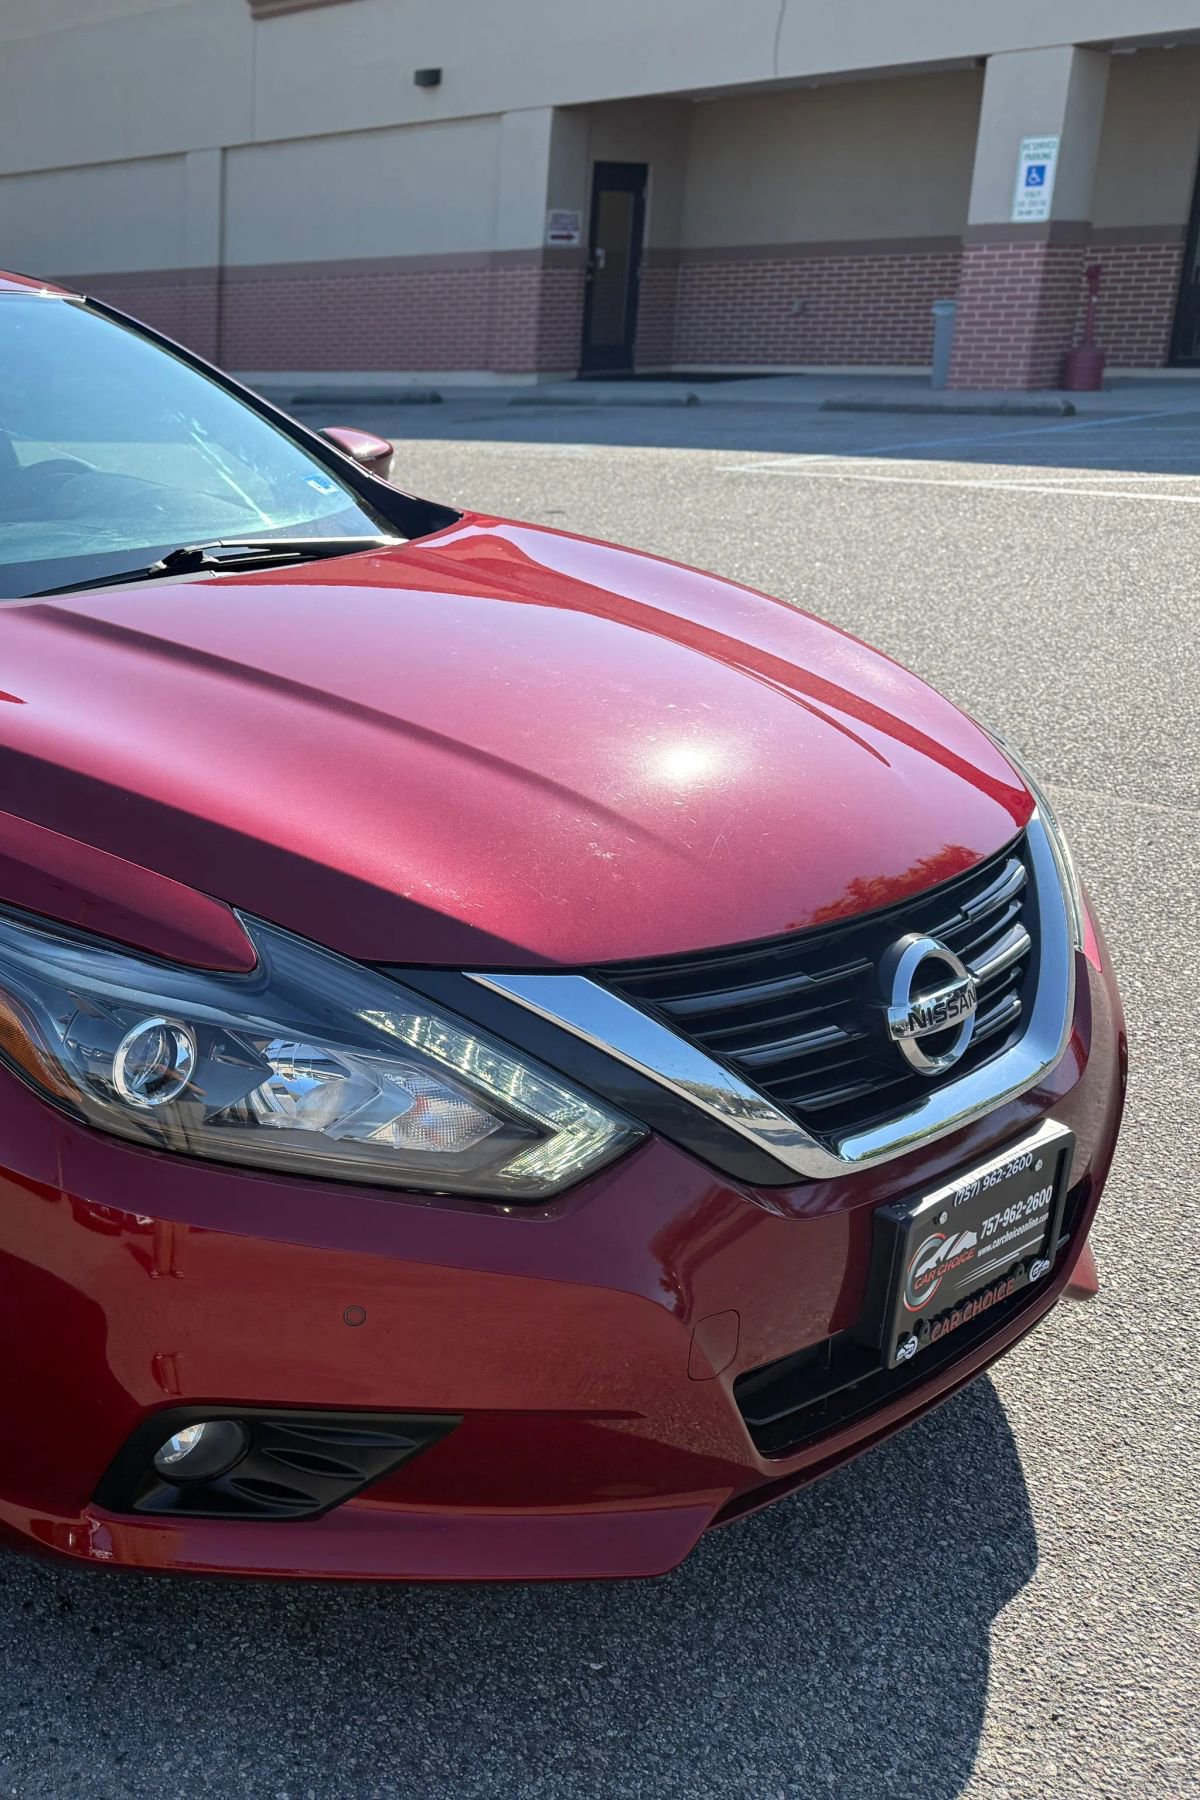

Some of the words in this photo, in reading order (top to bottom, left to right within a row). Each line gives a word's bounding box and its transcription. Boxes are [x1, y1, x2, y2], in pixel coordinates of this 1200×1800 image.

[907, 988, 976, 1031] NISSAN
[954, 1180, 981, 1207] (757)
[982, 1153, 1033, 1192] 962-2600
[977, 1212, 1049, 1257] www.carchoiceonline.com
[980, 1184, 1053, 1240] 757-962-2600
[914, 1270, 936, 1290] CAR
[937, 1247, 976, 1276] CHOICE
[931, 1310, 961, 1342] CAR
[962, 1277, 1016, 1321] CHOICE
